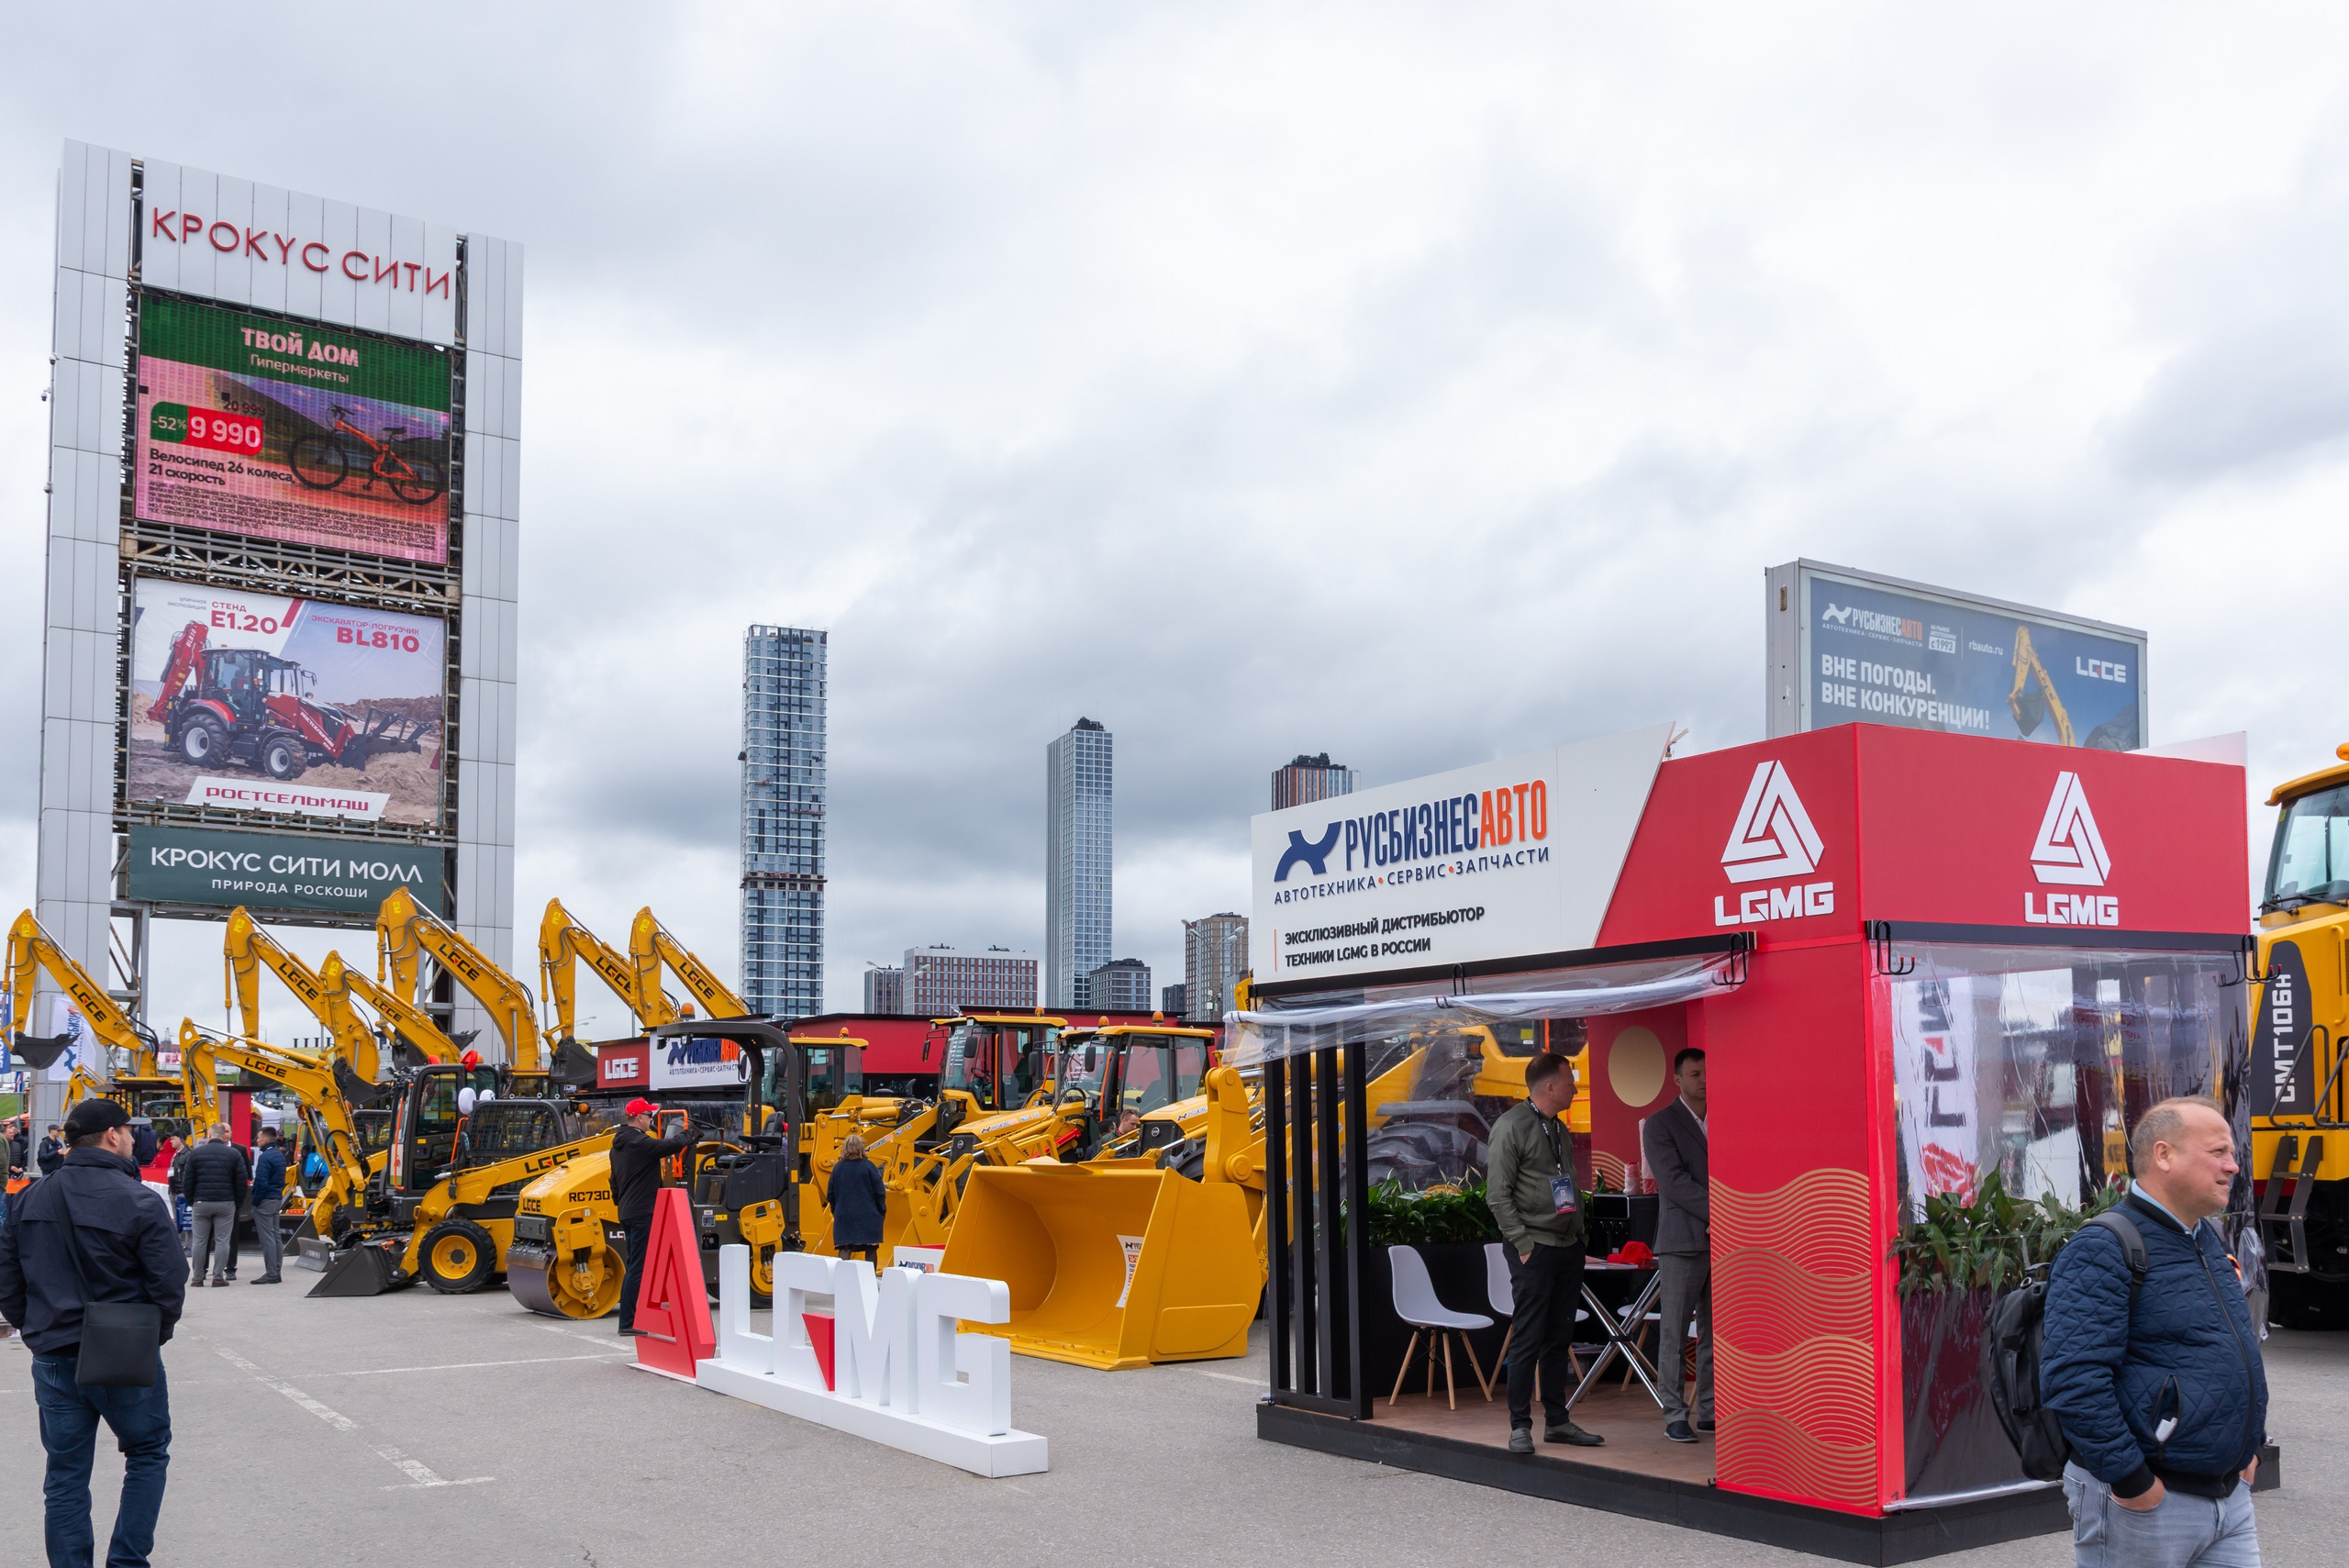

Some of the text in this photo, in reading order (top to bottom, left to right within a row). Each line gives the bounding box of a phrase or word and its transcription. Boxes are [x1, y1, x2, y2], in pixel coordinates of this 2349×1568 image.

[153, 206, 450, 299] КРОКУС СИТИ
[240, 327, 359, 367] ТВОЙ ДОМ
[250, 353, 349, 384] Гипермаркеты
[151, 416, 187, 431] -52%
[190, 416, 261, 449] 9 990
[149, 462, 226, 486] 21 скорость
[150, 448, 295, 484] Велосипед 26 колеса,
[211, 601, 247, 613] СТЕНД
[211, 610, 278, 634] E1.20
[311, 615, 420, 635] ЭКСКАВАТОР-ПОГРУЗЧИК
[1852, 608, 1923, 640] РУСБИЗНЕСАВТО
[337, 627, 420, 653] BL810
[1936, 639, 1954, 651] 1993
[1968, 640, 2004, 656] rbauto.ru
[1821, 653, 1936, 695] ВНЕ ПОГОДЫ.
[1821, 682, 1990, 730] ВНЕ КОНКУРЕНЦИИ!
[206, 787, 369, 812] РОСТСЕЛЬМАШ
[1345, 779, 1547, 872] РУСБИЗНЕСАВТО
[151, 847, 424, 884] КРОКУС СИТИ МОЛЛ
[1274, 847, 1550, 905] АВТОТЕХНИКА СЕРВИС ЗАПЧАСТИ
[212, 879, 368, 898] ПРИРОДА РОСКОШИ
[1714, 881, 1835, 927] LGMG
[2024, 891, 2120, 927] LGMG
[1285, 906, 1485, 946] ЭКСКЛЮЗИВНЫЙ ДИСТРИБЬЮТОР
[1286, 938, 1431, 967] ТЕХНИКИ LGMG В РОССИИ
[2272, 973, 2297, 1103] CMT106H
[717, 1064, 739, 1073] ЗАПЧАСТ
[569, 1190, 610, 1204] RC730
[609, 1230, 626, 1241] LG
[719, 1243, 1011, 1436] LGMG
